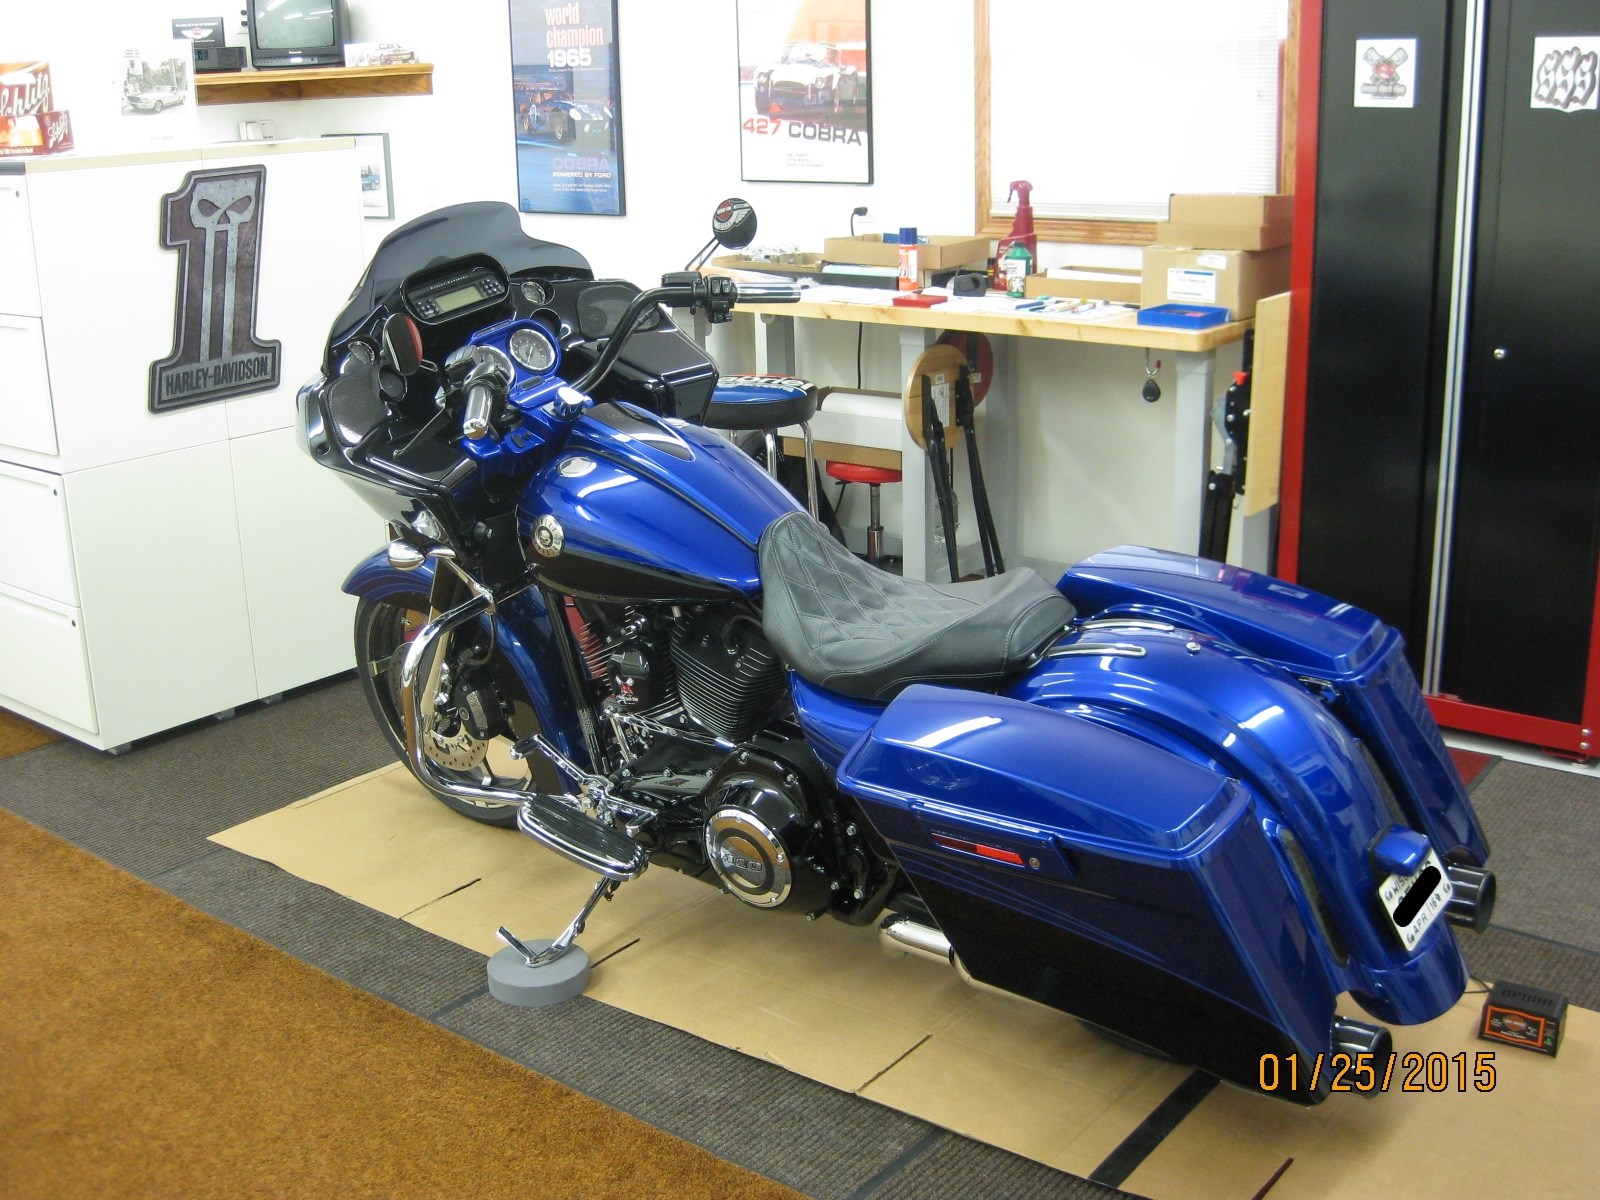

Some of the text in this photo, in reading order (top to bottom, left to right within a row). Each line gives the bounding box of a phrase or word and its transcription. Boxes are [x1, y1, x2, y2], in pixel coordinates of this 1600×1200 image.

[544, 2, 580, 26] world
[546, 24, 604, 50] champion
[547, 48, 592, 68] 1965
[742, 117, 862, 147] 427 COBRA
[552, 157, 610, 170] COBRA
[166, 355, 269, 396] HARLEY-DAVIDSON
[1412, 912, 1428, 934] APR
